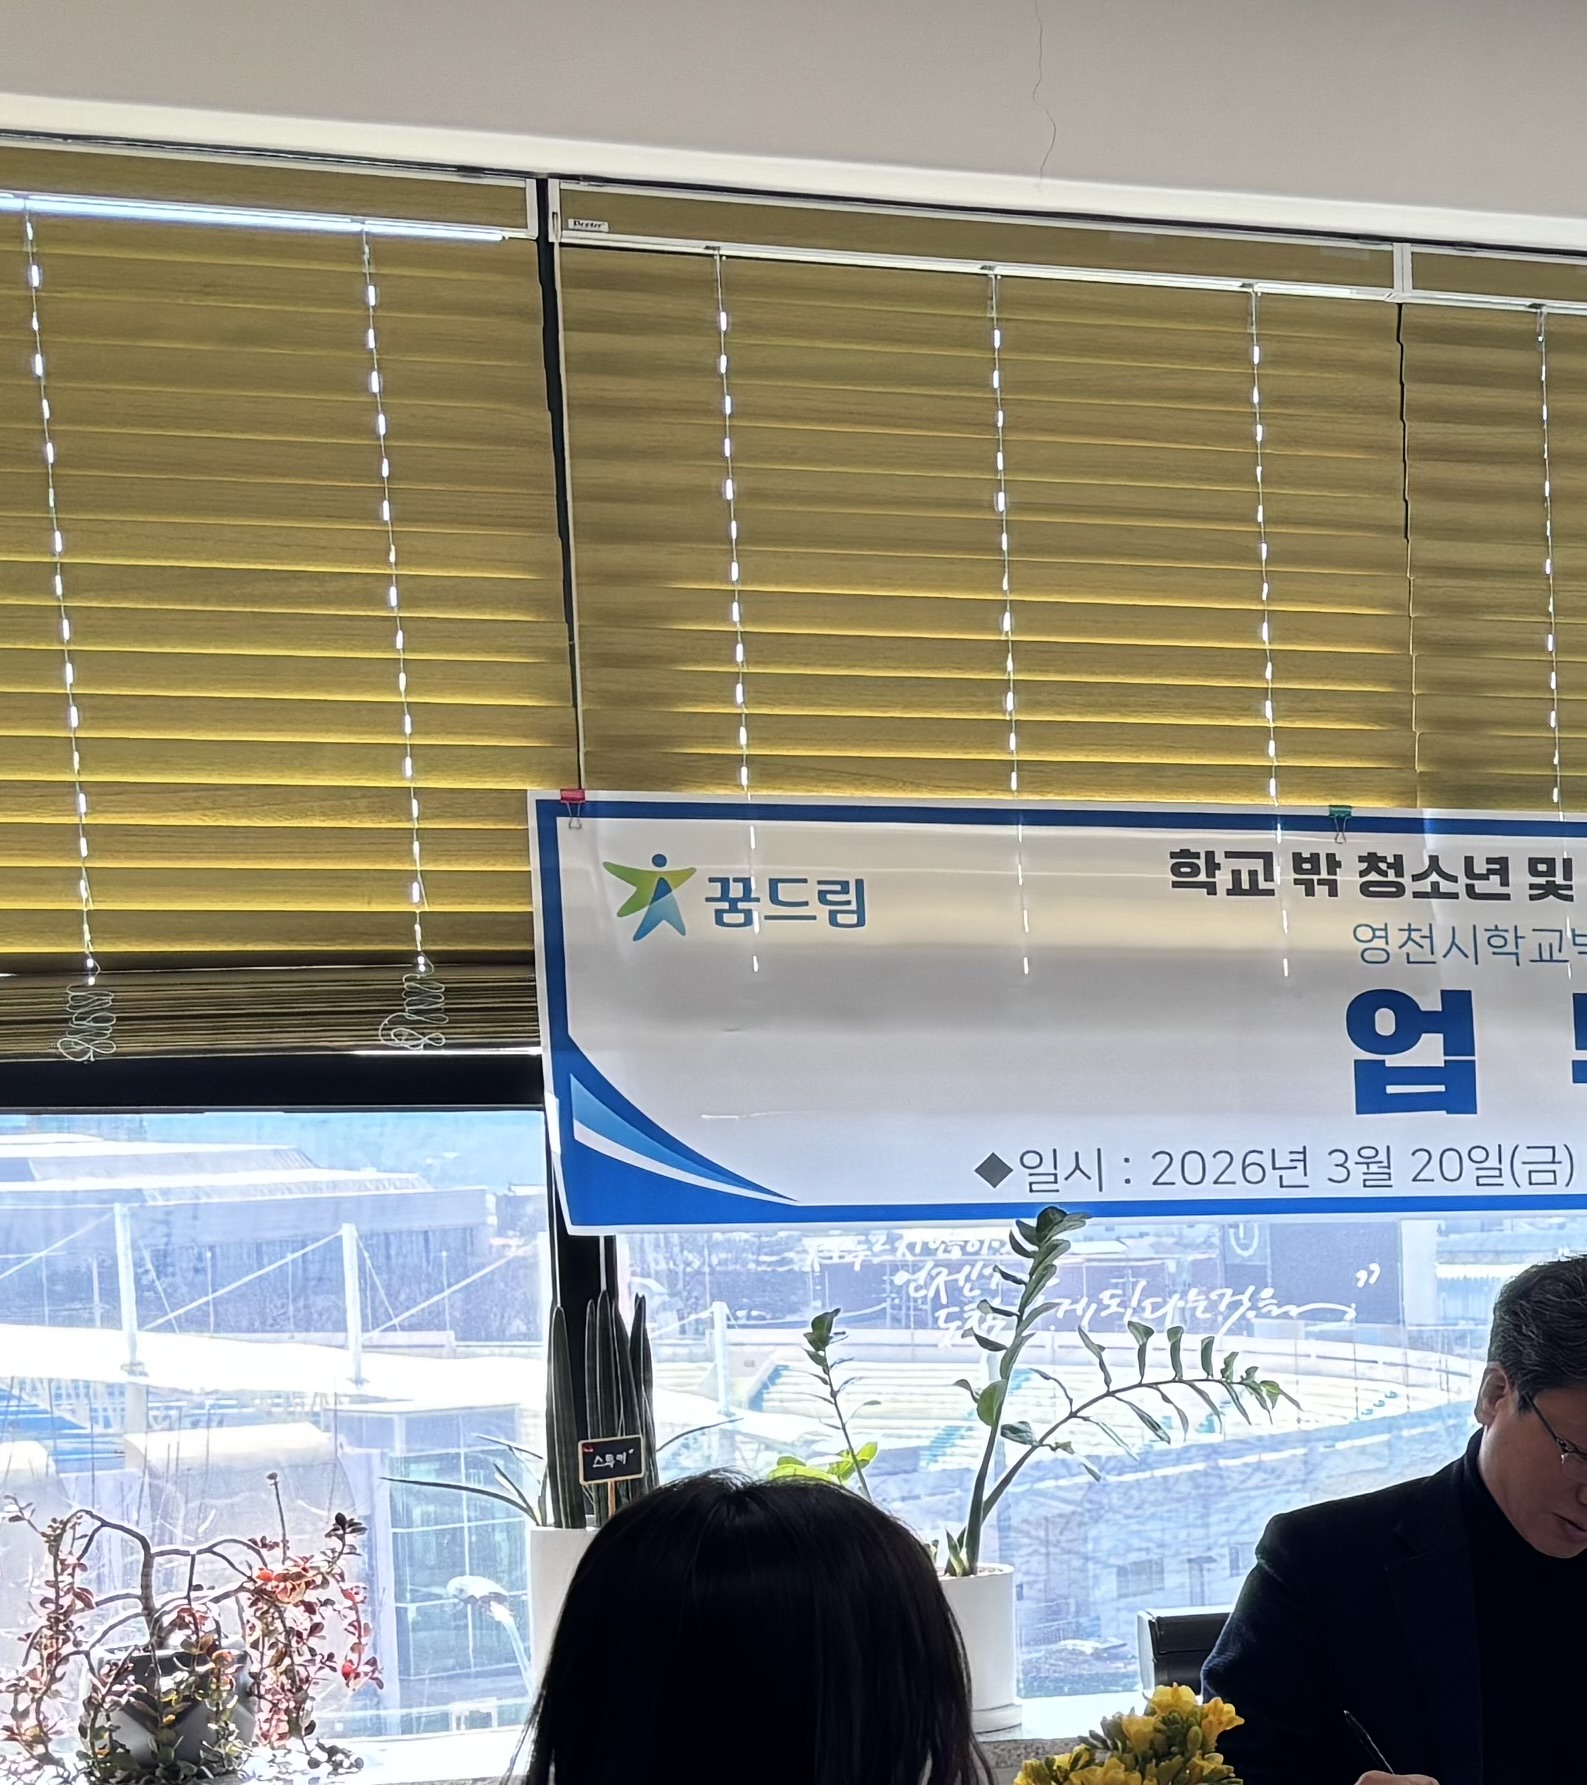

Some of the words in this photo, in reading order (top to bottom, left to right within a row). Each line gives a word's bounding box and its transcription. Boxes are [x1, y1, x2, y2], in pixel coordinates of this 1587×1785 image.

[1169, 848, 1276, 898] 학교
[1292, 852, 1341, 898] 밖
[1357, 854, 1511, 903] 청소년
[1527, 856, 1575, 903] 및
[705, 877, 865, 929] 꿈드림
[1019, 1149, 1104, 1193] 일시
[1151, 1147, 1310, 1188] 2026년
[1326, 1144, 1394, 1188] 3월
[1411, 1143, 1575, 1189] 20일(금)
